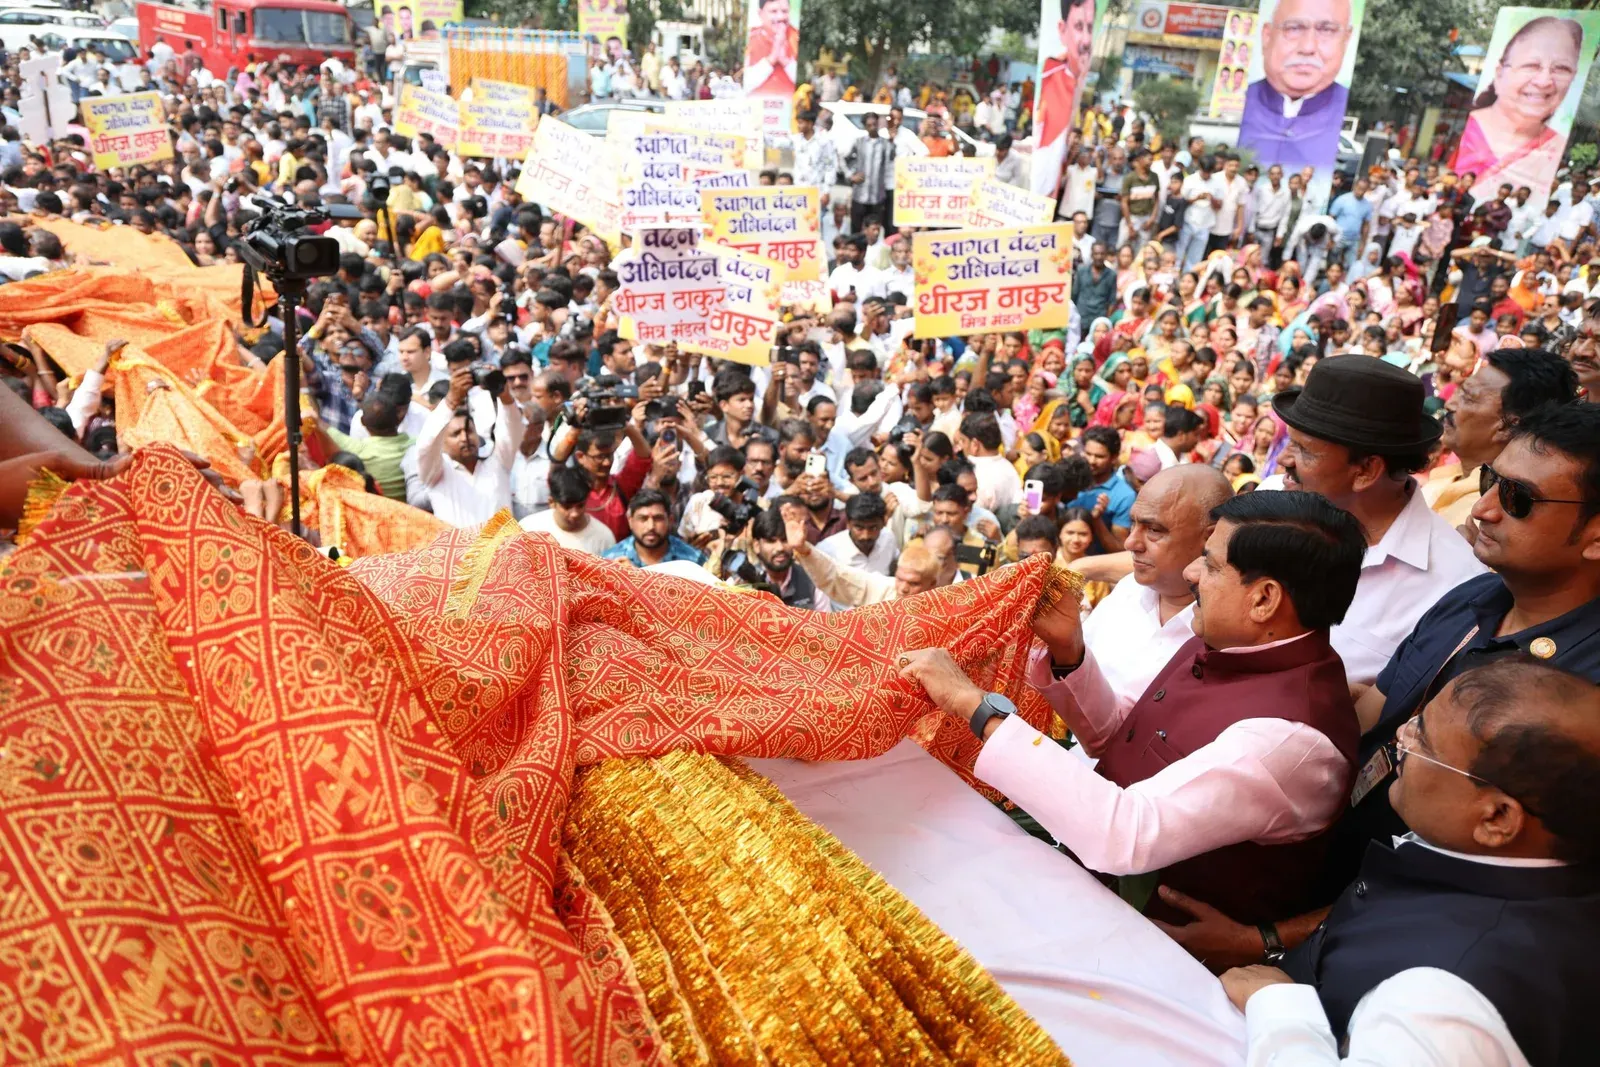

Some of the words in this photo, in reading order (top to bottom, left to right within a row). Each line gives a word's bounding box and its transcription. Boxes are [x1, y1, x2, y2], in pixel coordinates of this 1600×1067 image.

[90, 101, 127, 117] स्वागत
[130, 97, 154, 111] वंदन
[104, 114, 150, 131] अभिनंदन
[435, 123, 458, 143] ठाकु
[94, 132, 131, 154] धीरज
[133, 128, 168, 152] ठाकुर
[461, 127, 497, 145] धीरज
[634, 136, 688, 155] स्वागत
[526, 157, 573, 194] धीरज
[642, 157, 682, 181] वंदन
[626, 182, 699, 211] अभिनंदन
[713, 196, 767, 213] स्वागत
[772, 190, 808, 212] वंदन
[897, 190, 941, 211] धीरज
[728, 212, 798, 234] अभिनंदन
[767, 239, 818, 269] ठाकुर
[929, 236, 1000, 259] स्वागत
[1008, 231, 1057, 253] वंदन
[621, 250, 719, 284] अभिनंदन
[726, 254, 771, 283] वंदन
[946, 255, 1041, 281] अभिनंदन
[615, 289, 666, 315] धीरज
[671, 286, 727, 317] ठाकुर
[918, 284, 991, 315] धीरज
[997, 282, 1067, 315] ठाकुर
[637, 322, 667, 341] मित्र
[671, 318, 707, 339] मंडल
[709, 309, 774, 345] ठाकुर
[960, 314, 987, 329] मित्र
[990, 312, 1024, 327] मंडल
